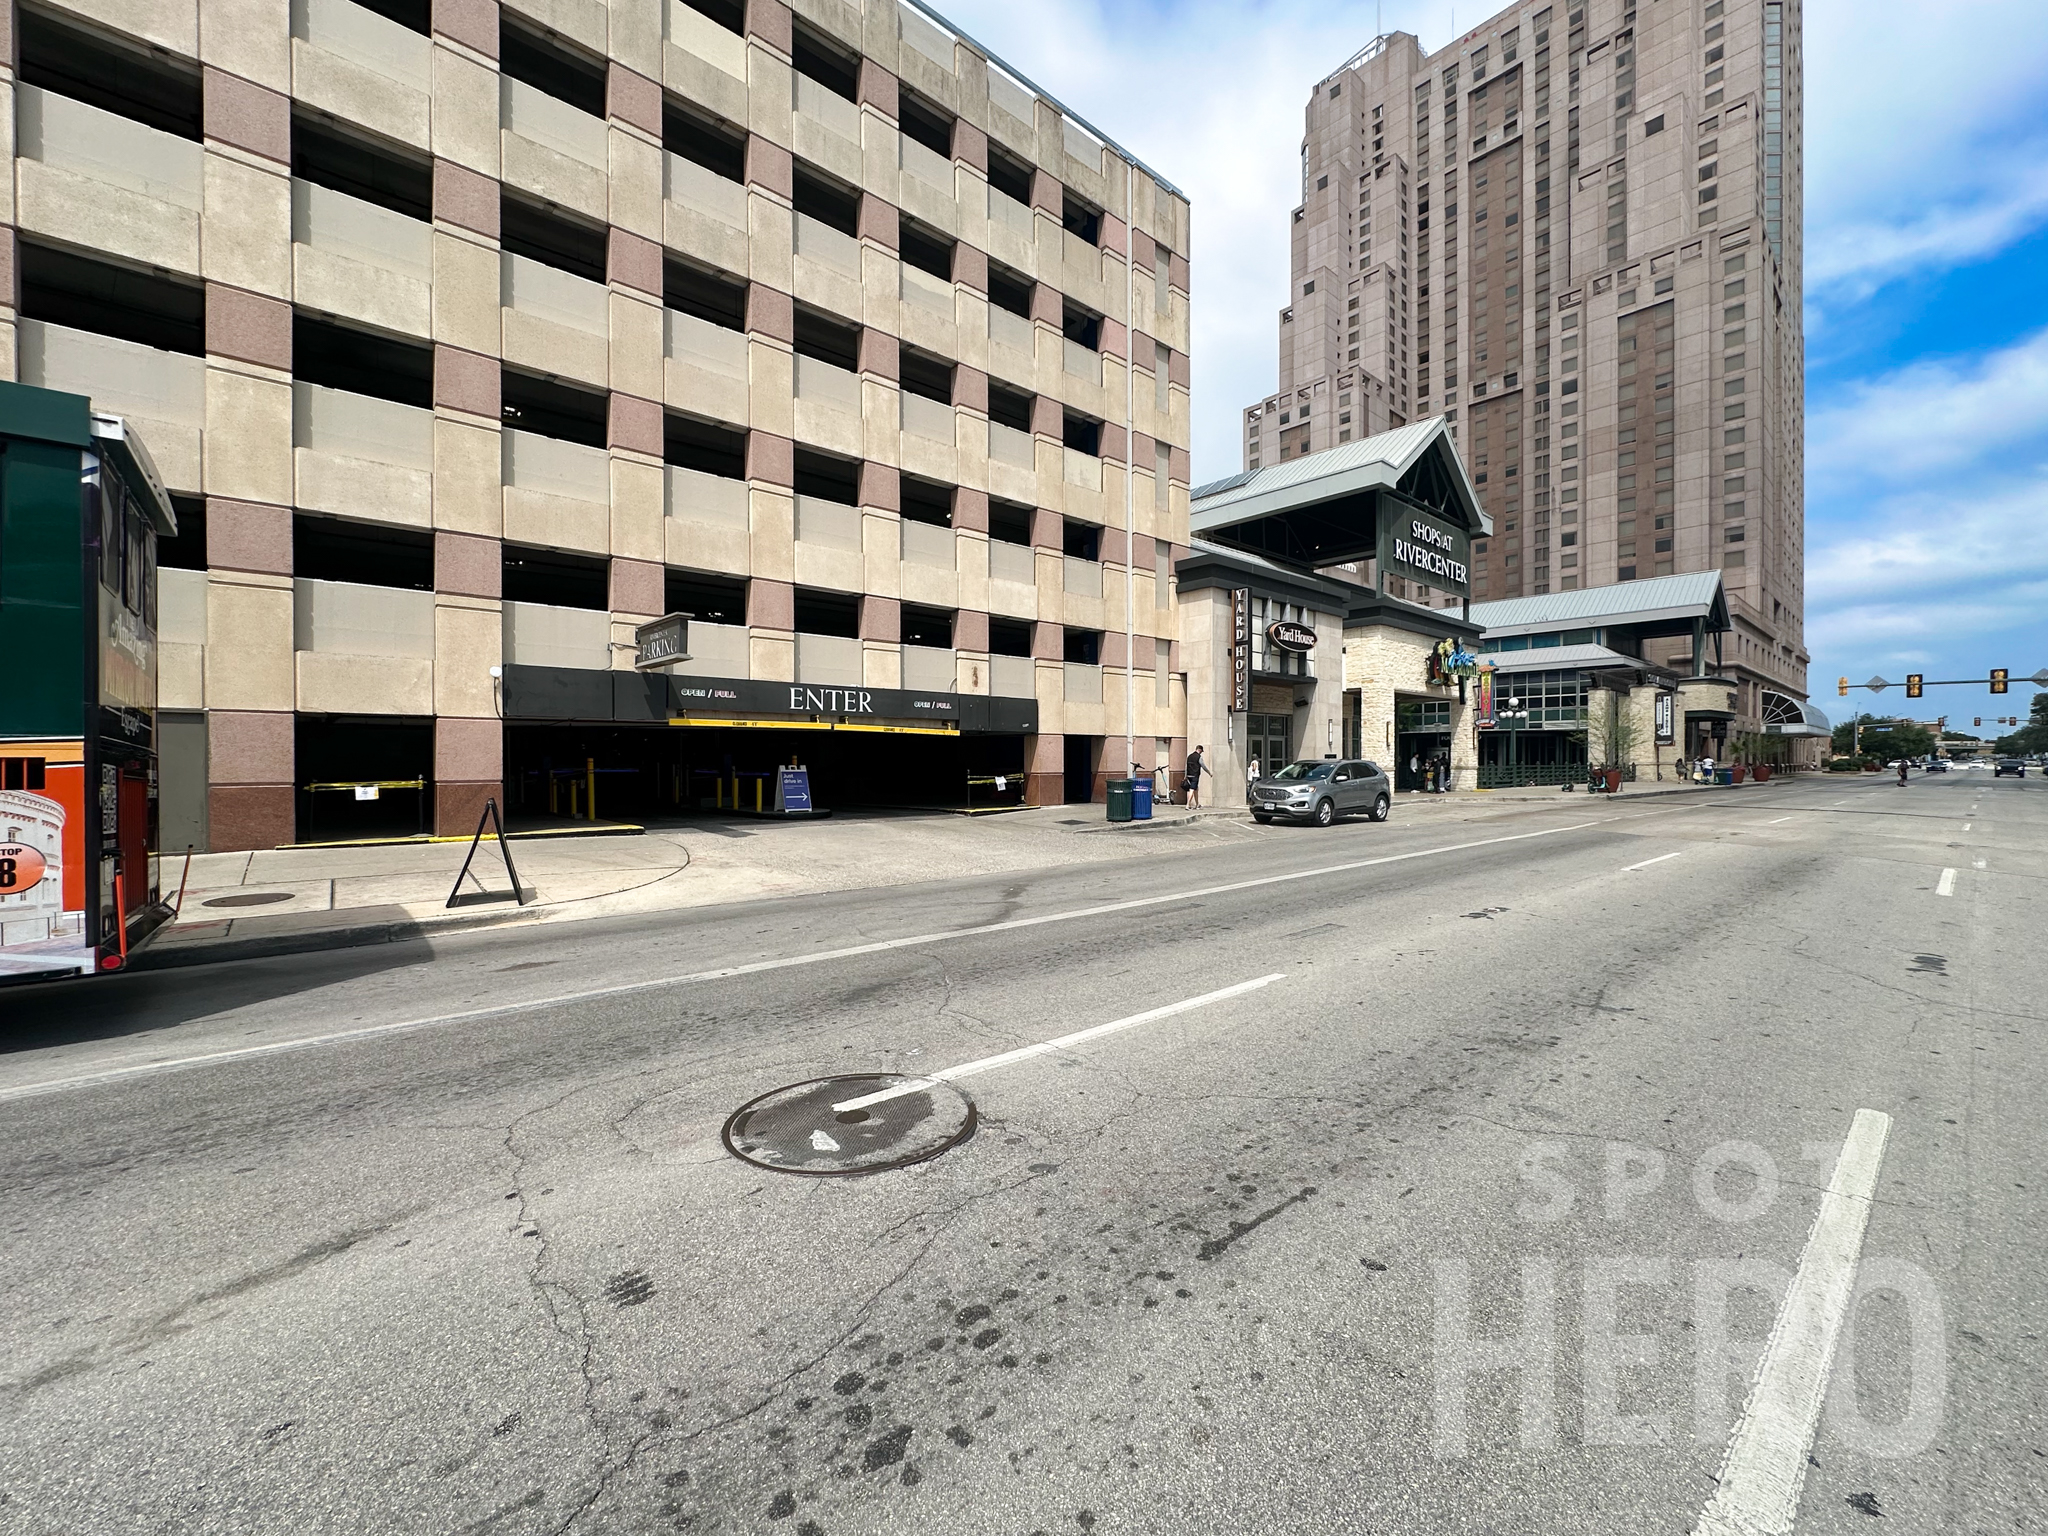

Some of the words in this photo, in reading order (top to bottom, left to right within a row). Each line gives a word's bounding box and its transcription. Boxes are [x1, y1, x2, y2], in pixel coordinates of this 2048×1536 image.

[1412, 520, 1440, 547] SHOPS
[1442, 534, 1453, 552] AT
[1395, 538, 1468, 584] RIVERCENTER
[1236, 589, 1244, 640] YARD
[642, 634, 678, 661] PARKING
[1278, 626, 1294, 642] Yard
[1295, 629, 1315, 646] House
[1235, 646, 1244, 709] HOUSE
[681, 688, 706, 697] OPEN
[714, 690, 737, 699] FULL
[789, 687, 873, 713] ENTER
[0, 848, 23, 856] TOP
